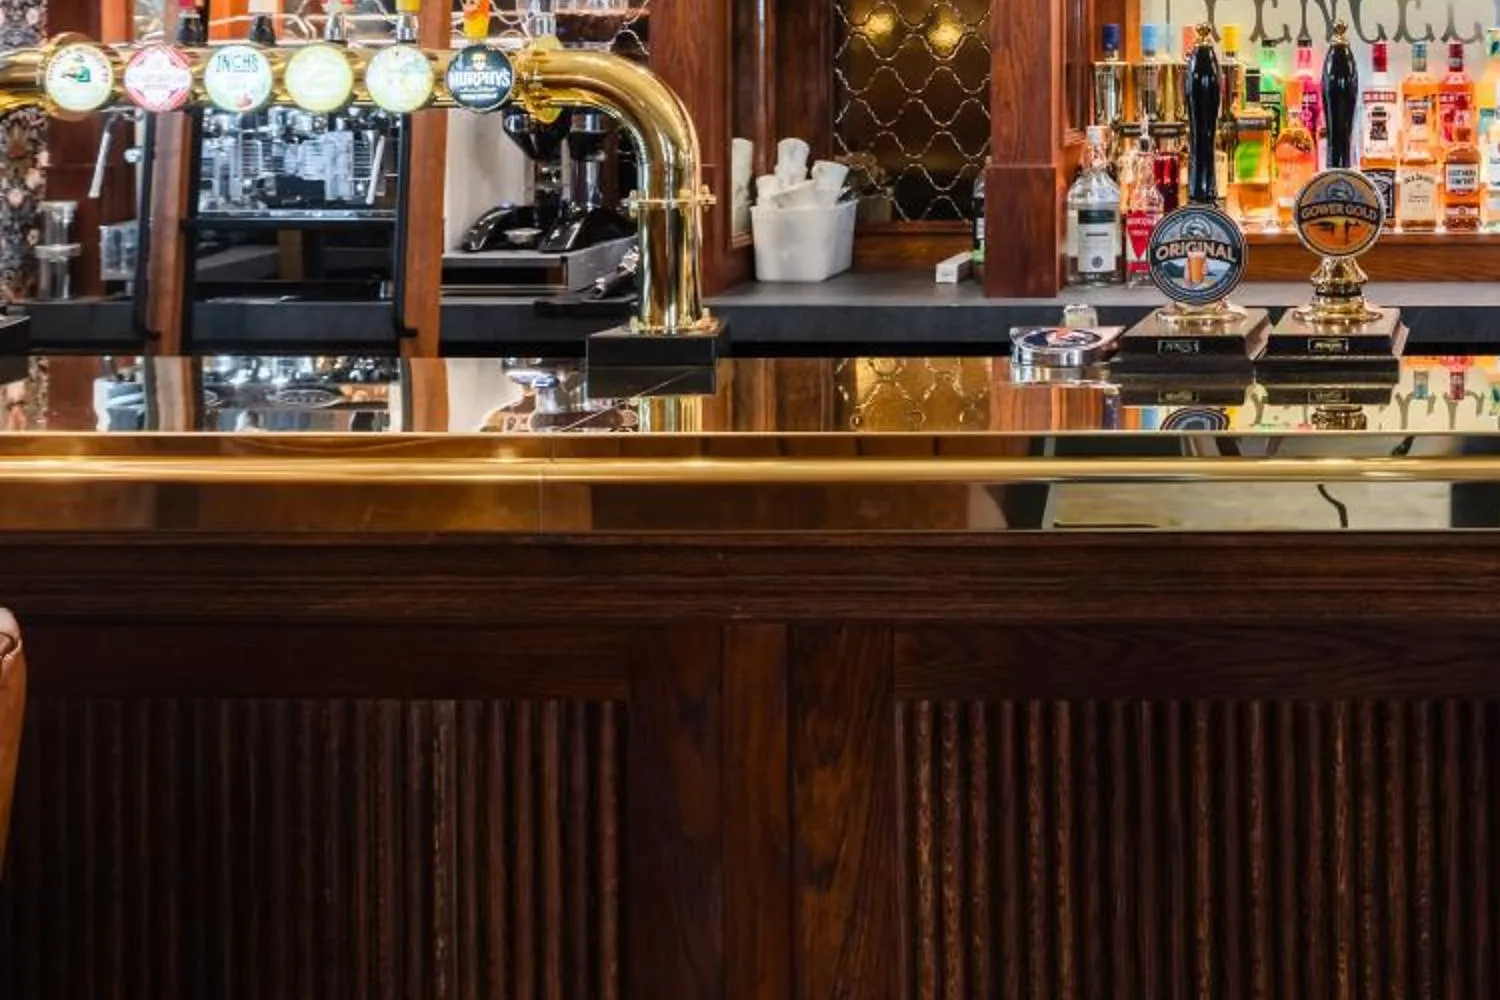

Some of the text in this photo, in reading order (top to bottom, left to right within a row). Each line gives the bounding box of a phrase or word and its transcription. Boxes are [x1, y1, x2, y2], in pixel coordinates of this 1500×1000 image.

[1301, 203, 1379, 220] GOWER GOLD
[1154, 239, 1238, 263] ORIGINAL
